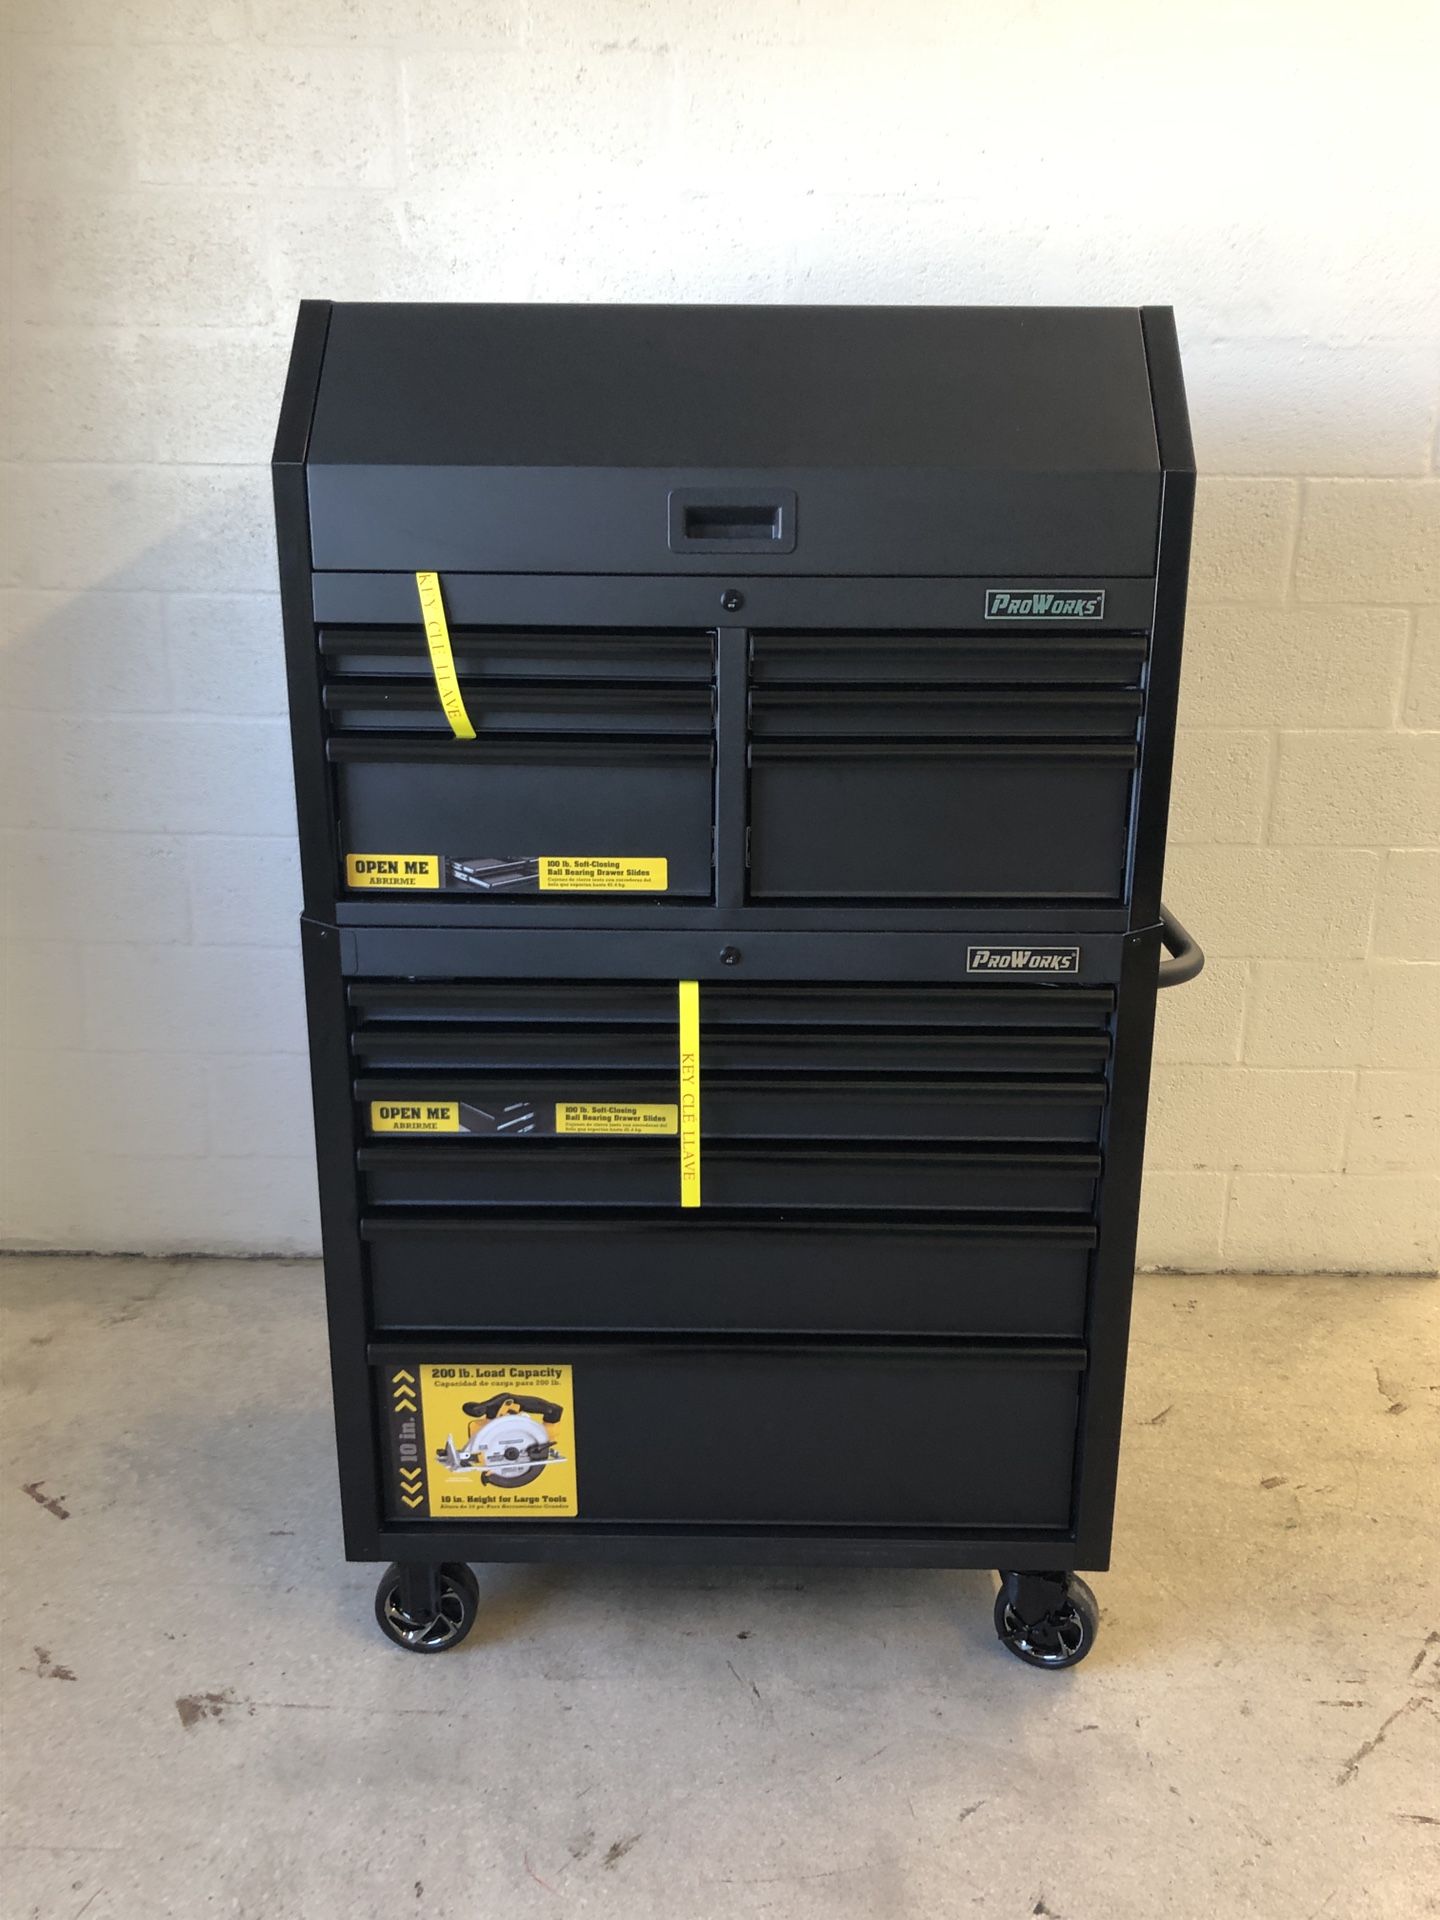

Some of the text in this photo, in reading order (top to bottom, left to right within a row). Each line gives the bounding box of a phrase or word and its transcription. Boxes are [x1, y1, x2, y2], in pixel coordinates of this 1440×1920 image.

[355, 860, 429, 875] OPEN ME
[574, 860, 620, 869] Soft-Closing
[565, 869, 595, 877] Bearing
[369, 877, 416, 885] ABRIRME
[380, 1107, 450, 1120] OPEN ME
[592, 1106, 637, 1115] Soft-Closing
[582, 1114, 612, 1122] Bearing
[682, 1053, 695, 1181] KEY CLE LLAVE
[432, 1367, 562, 1379] 200 lb. Load Capacity
[399, 1417, 418, 1462] 10 in.
[441, 1495, 451, 1503] 10
[467, 1495, 496, 1504] Height
[499, 1495, 511, 1503] for
[514, 1495, 540, 1504] Large
[541, 1495, 567, 1503] Tools
